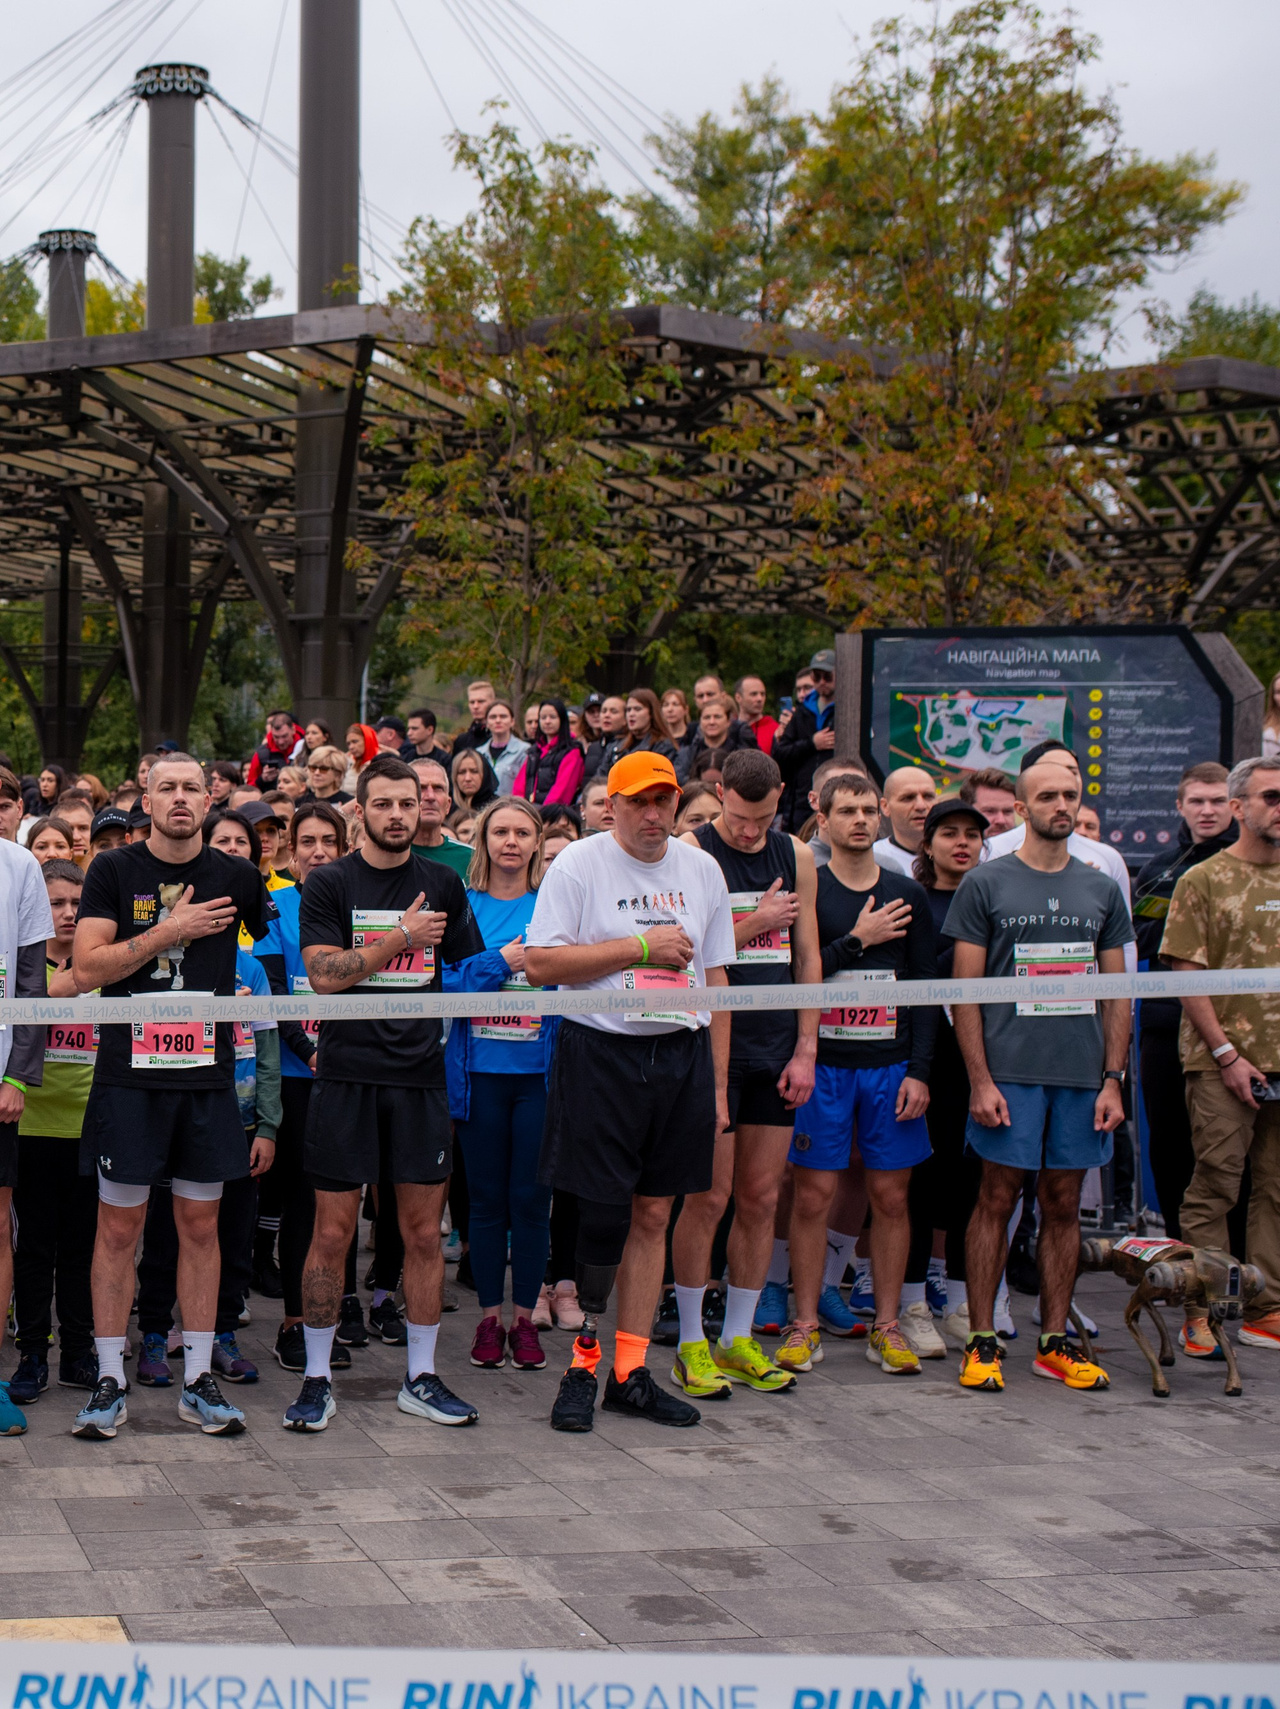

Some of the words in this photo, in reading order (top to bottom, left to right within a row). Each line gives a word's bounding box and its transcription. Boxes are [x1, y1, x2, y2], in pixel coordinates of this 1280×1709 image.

[947, 647, 1049, 666] НАВІГАЦІЙНА
[1053, 649, 1101, 664] МАПА
[986, 668, 1037, 679] Navigation
[1039, 669, 1061, 679] map
[133, 900, 157, 911] BRAVE
[133, 911, 149, 920] BEAR
[1000, 915, 1046, 929] SPORT
[1052, 916, 1080, 927] FOR
[838, 1008, 879, 1026] 1927
[46, 1030, 86, 1049] 1940
[153, 1034, 194, 1053] 1980
[157, 1058, 199, 1067] ПриватБанк
[12, 1673, 128, 1709] RUN
